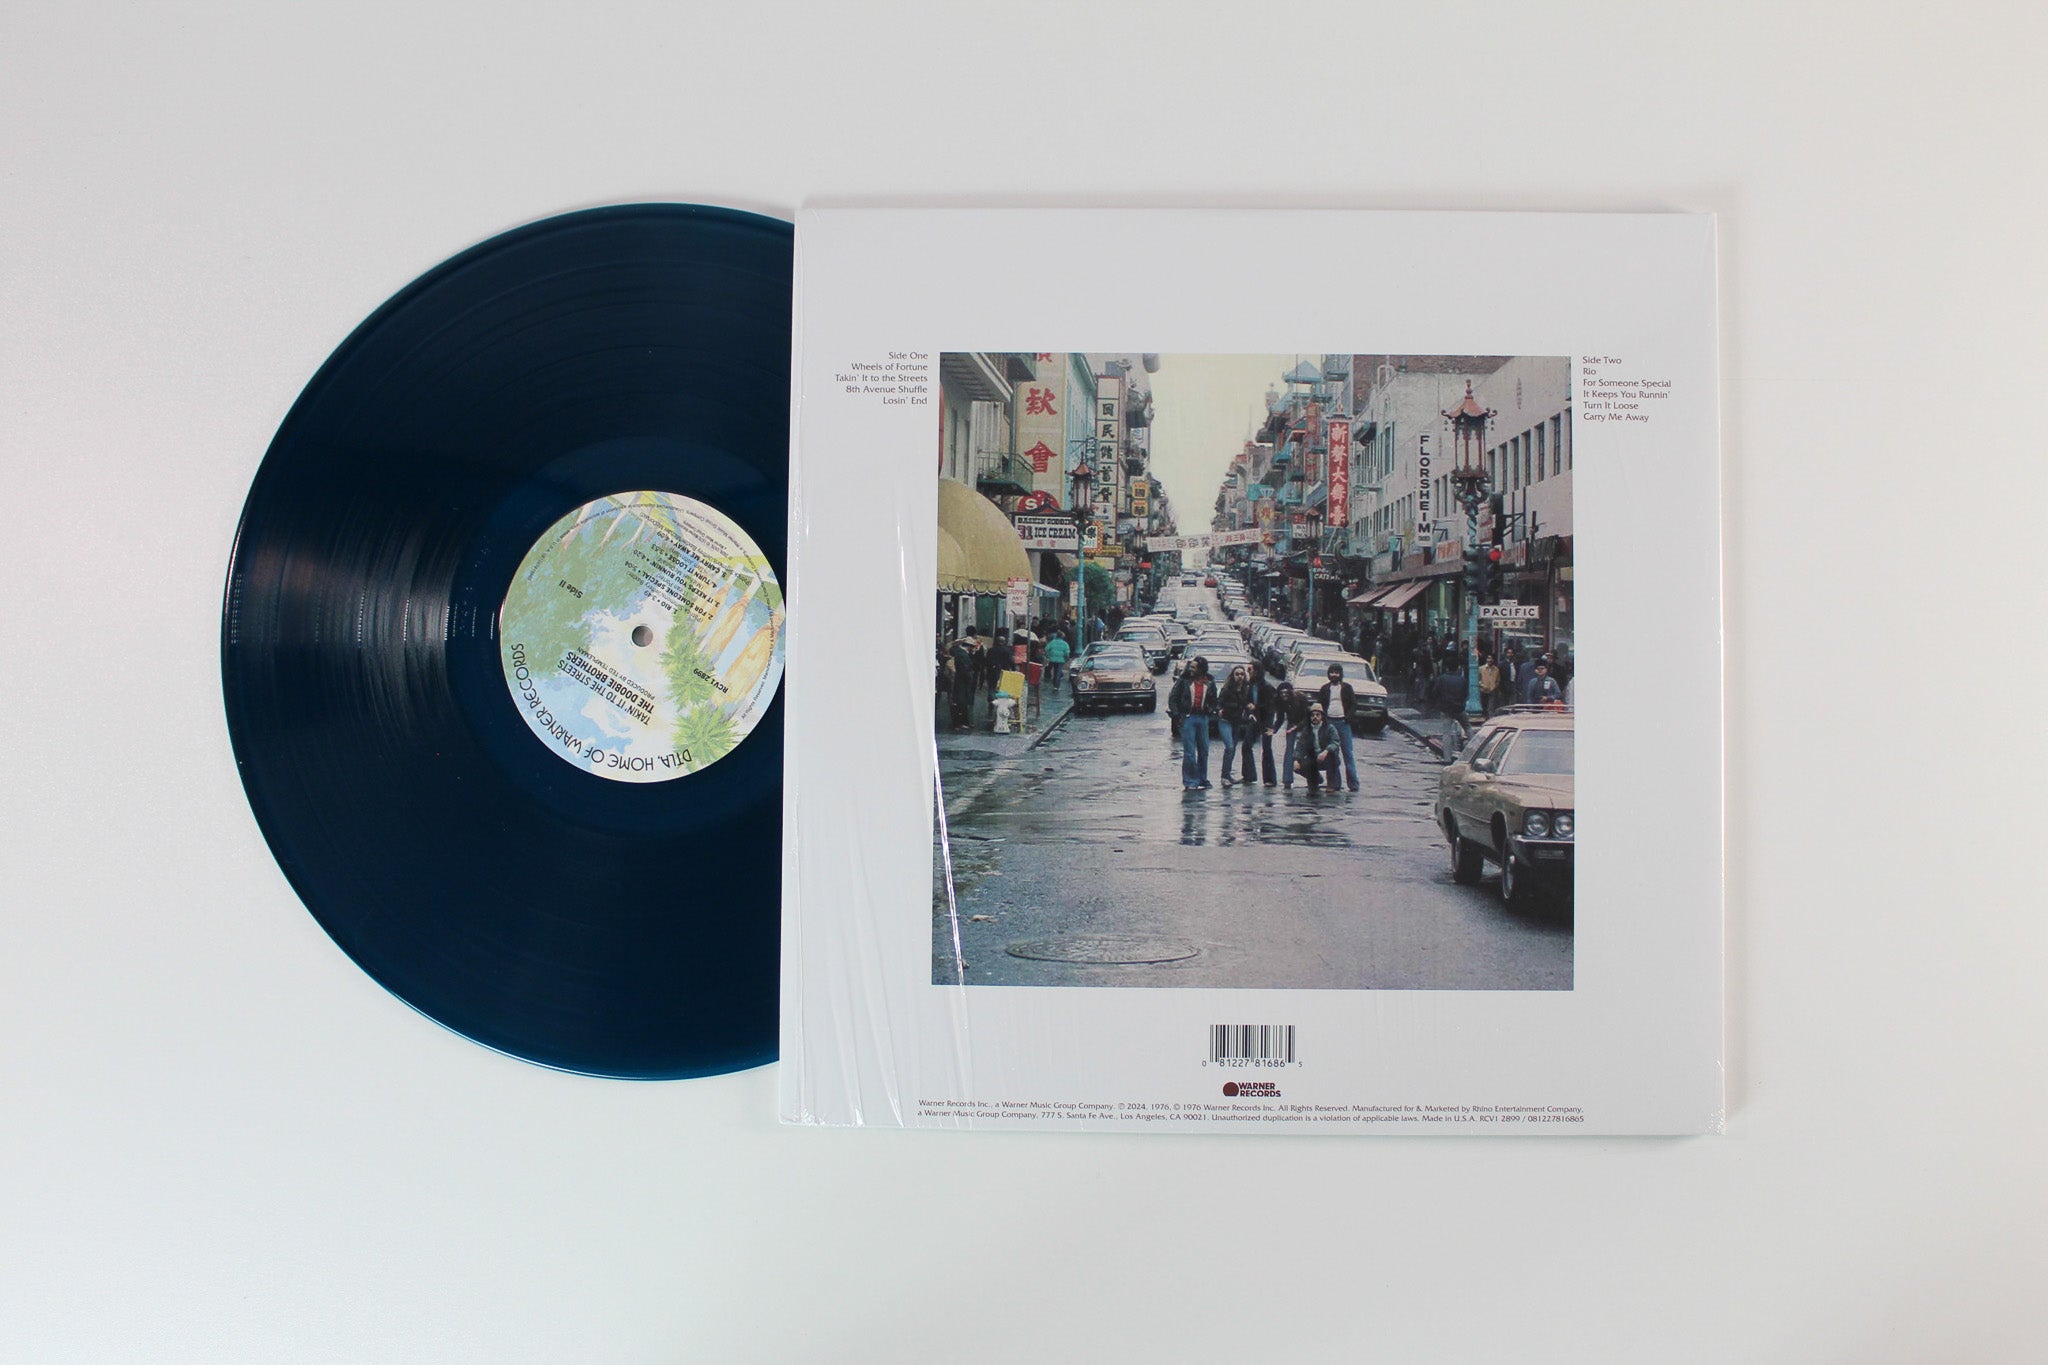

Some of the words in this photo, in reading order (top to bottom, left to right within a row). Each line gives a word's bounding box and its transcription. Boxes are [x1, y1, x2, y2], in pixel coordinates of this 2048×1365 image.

[1642, 380, 1671, 388] Special
[1592, 390, 1618, 399] Keeps
[1584, 413, 1606, 422] Carry
[1625, 414, 1649, 422] Away
[1418, 435, 1430, 533] FLORSHEIM
[1018, 525, 1033, 540] 31
[1035, 527, 1047, 538] ICE
[1048, 527, 1076, 539] CREAM
[673, 540, 691, 554] AWAY
[667, 554, 688, 570] LOOSE
[690, 551, 700, 561] ME
[700, 558, 720, 573] CARRY
[640, 570, 666, 589] SPECIAL
[674, 575, 688, 587] YOU
[693, 570, 710, 584] TURN
[564, 583, 584, 599] Side
[664, 586, 694, 608] SOMEONE
[686, 584, 707, 599] KEEPS
[659, 600, 672, 611] RIO
[693, 604, 707, 616] FOR
[1483, 608, 1535, 616] PACIFIC
[576, 646, 609, 670] TEMPLEMAN
[556, 658, 592, 686] STREETS
[564, 650, 609, 683] BROTHERS
[607, 666, 619, 676] TED
[692, 667, 710, 681] 2899
[511, 642, 541, 708] RECORDS
[589, 680, 607, 696] THE
[606, 677, 639, 703] DOOBIE
[625, 678, 655, 700] PRODUCED
[709, 678, 728, 693] RCV1
[604, 690, 618, 703] TO
[615, 697, 626, 708] IT
[636, 697, 655, 713] THE
[537, 706, 580, 753] WARNER
[583, 747, 604, 762] OF
[607, 754, 652, 770] HOME
[1220, 1059, 1249, 1067] 81227
[1255, 1059, 1285, 1067] 81686
[1291, 1105, 1312, 1113] Rights
